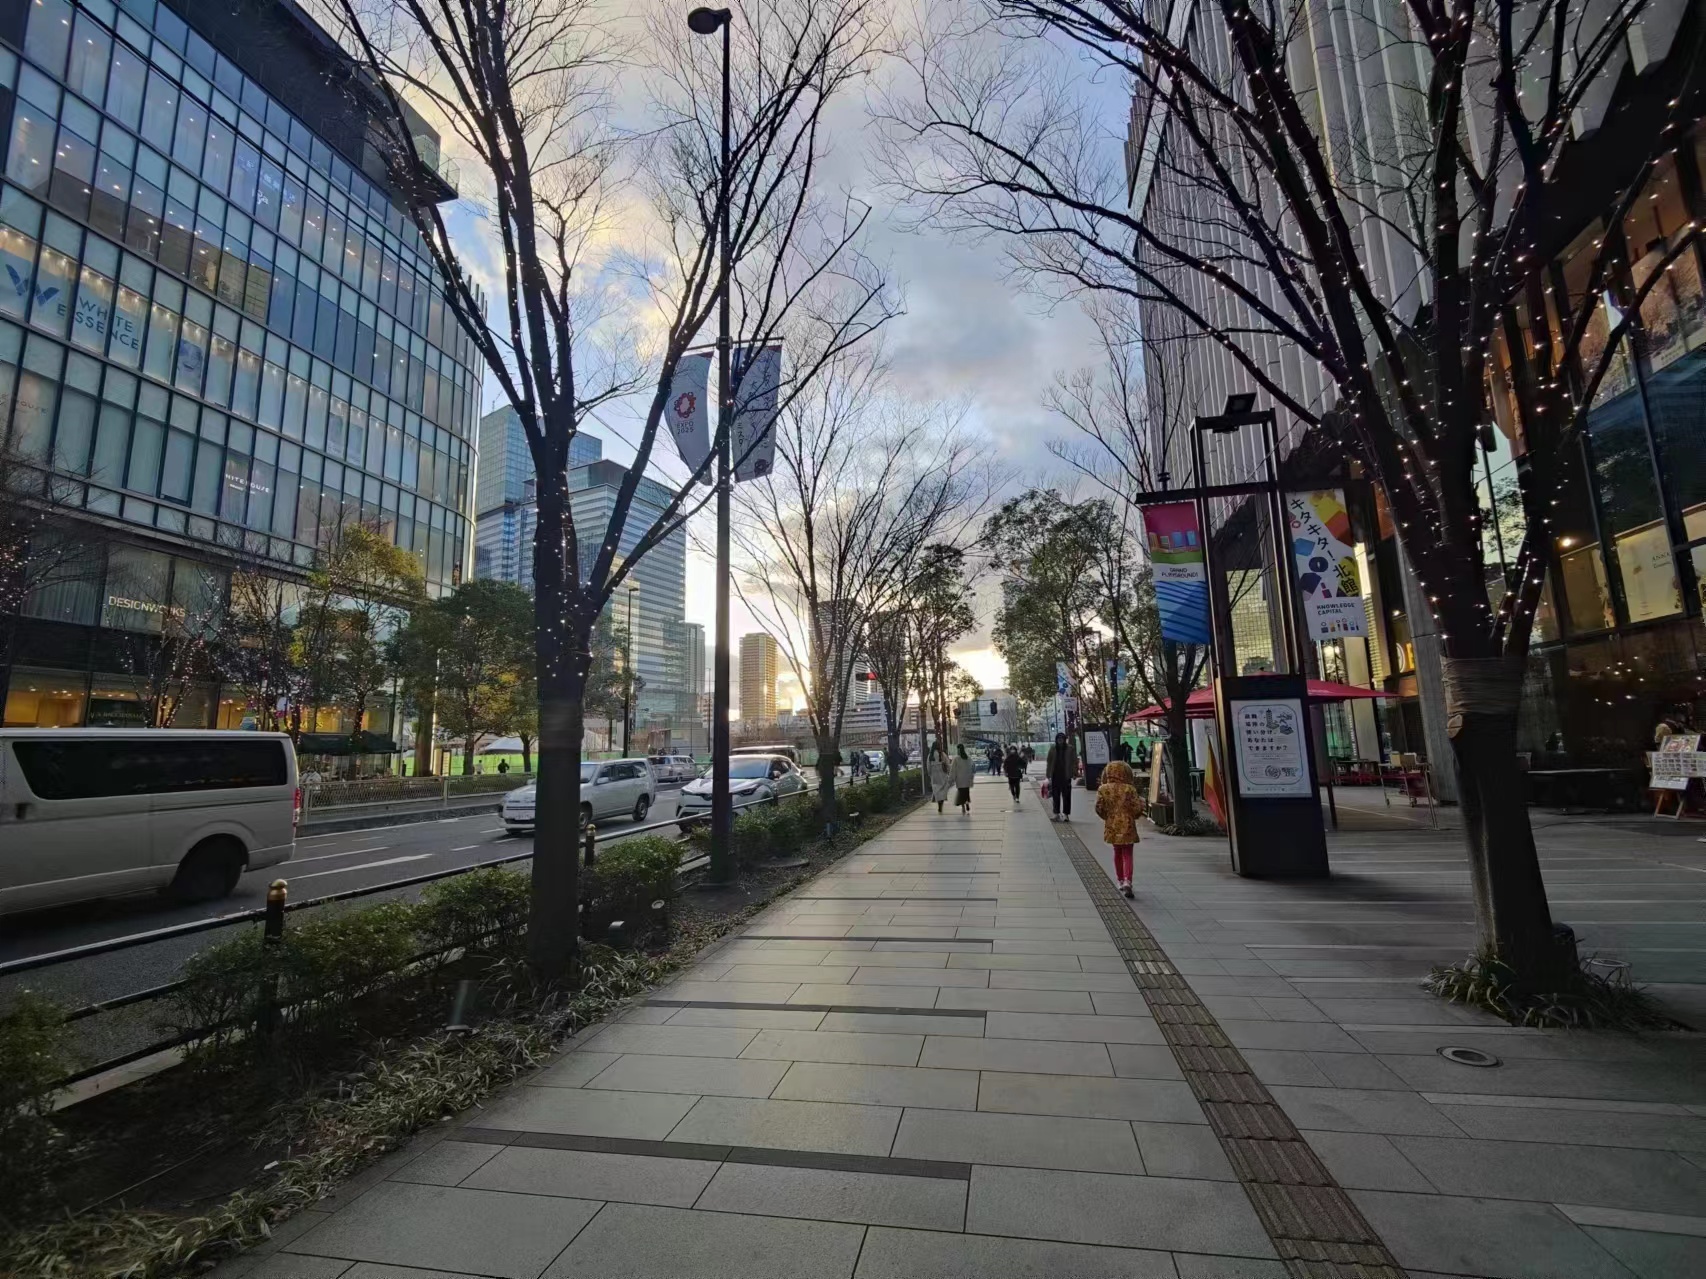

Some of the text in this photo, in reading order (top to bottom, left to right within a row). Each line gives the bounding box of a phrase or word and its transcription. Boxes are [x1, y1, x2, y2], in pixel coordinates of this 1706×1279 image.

[79, 295, 133, 333] WHTE
[677, 427, 694, 435] 2025
[108, 595, 186, 618] DESIGNWOKS
[1316, 602, 1356, 610] KNOWLEDGE
[1317, 608, 1343, 616] CAPITAL
